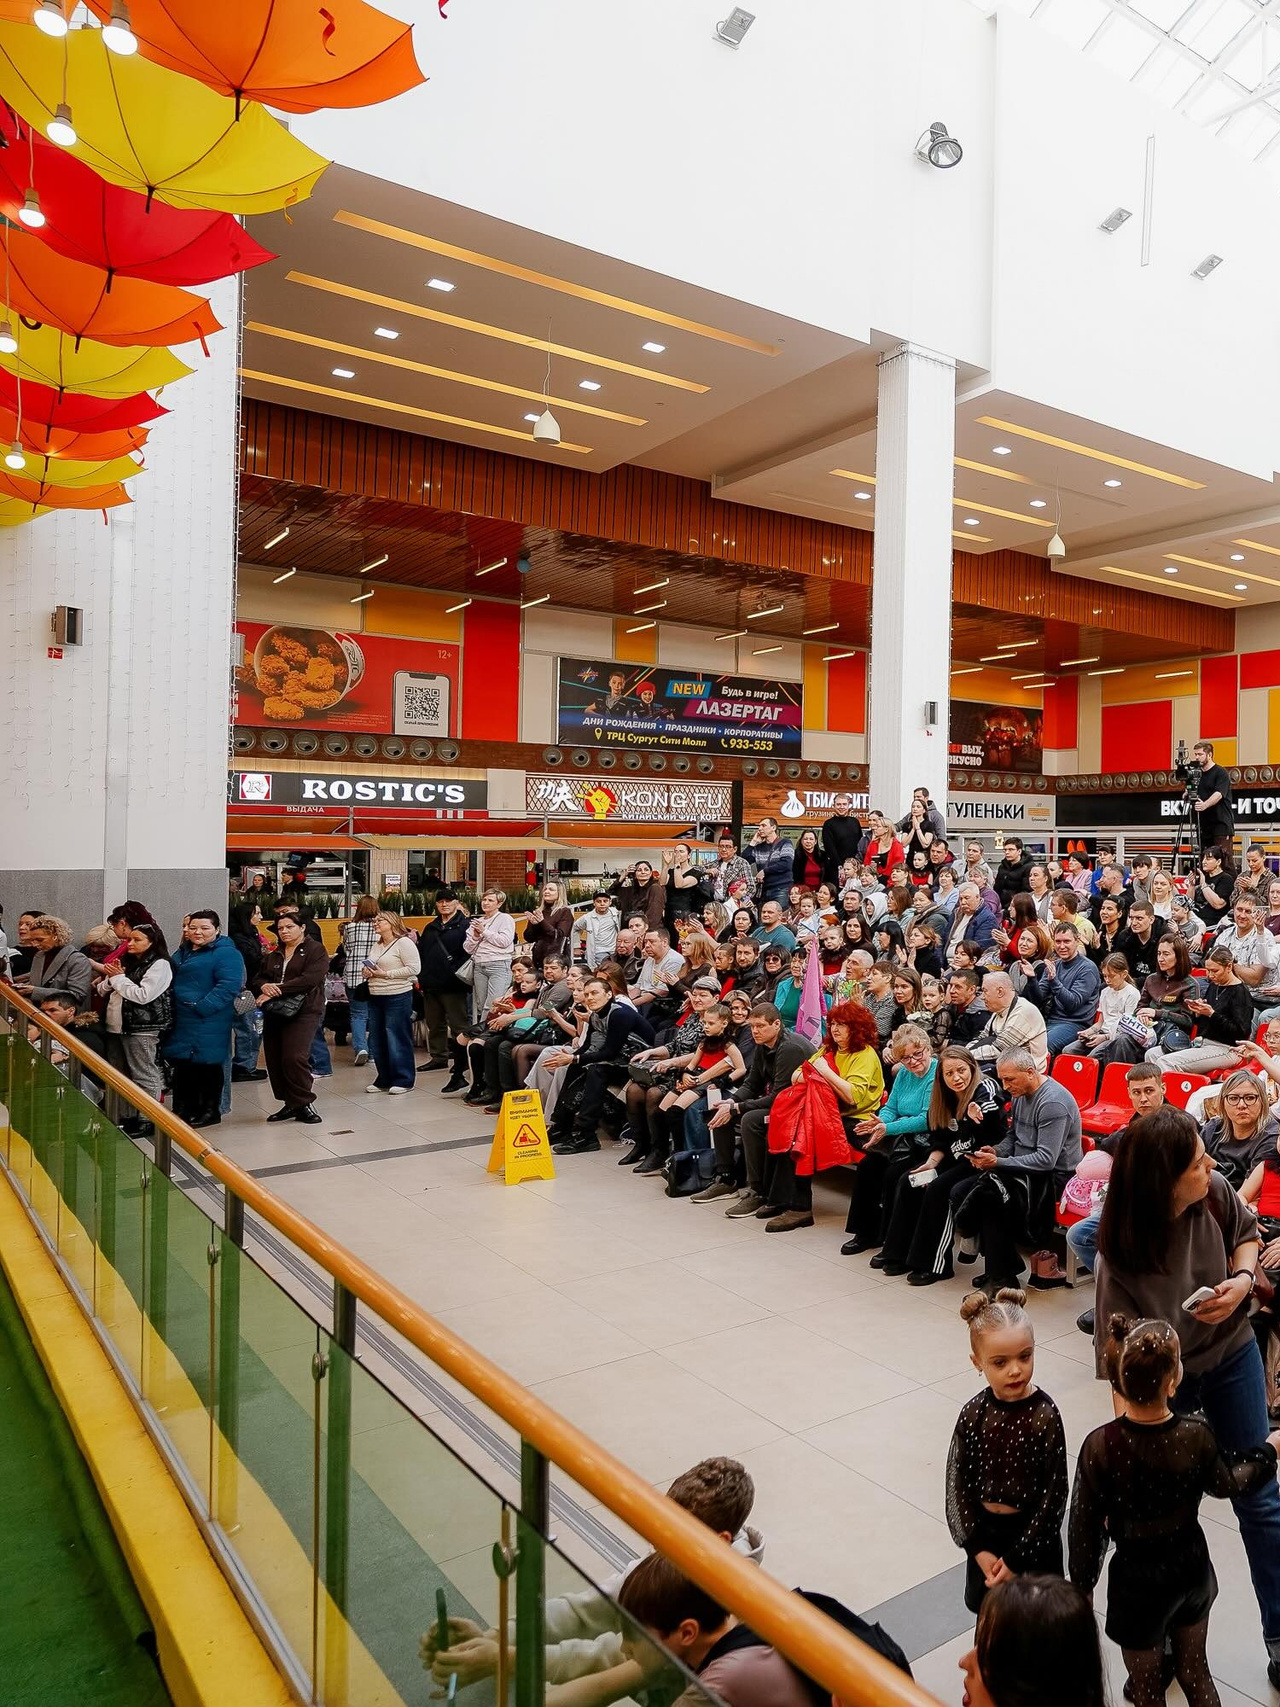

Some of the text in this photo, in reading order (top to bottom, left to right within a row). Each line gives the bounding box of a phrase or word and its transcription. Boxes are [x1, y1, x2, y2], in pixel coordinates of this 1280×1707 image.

[437, 650, 452, 659] 12+
[672, 682, 706, 696] NEW
[721, 685, 744, 697] Будь
[753, 689, 779, 700] игре!
[696, 700, 783, 721] ЛАЗЕРТАГ
[583, 717, 783, 739] ДНИ РОЖДЕНИЯ ПРАЗДНИКИ КОРПОРАТИВЫ
[606, 731, 707, 747] ТРЦ Сургут Сити Молл
[729, 739, 773, 751] 933-553
[948, 743, 985, 756] ЕРВЫХ,
[302, 778, 465, 803] ROSTIC'S
[620, 791, 722, 809] KONG FU
[286, 805, 325, 813] ВЫДАЧА
